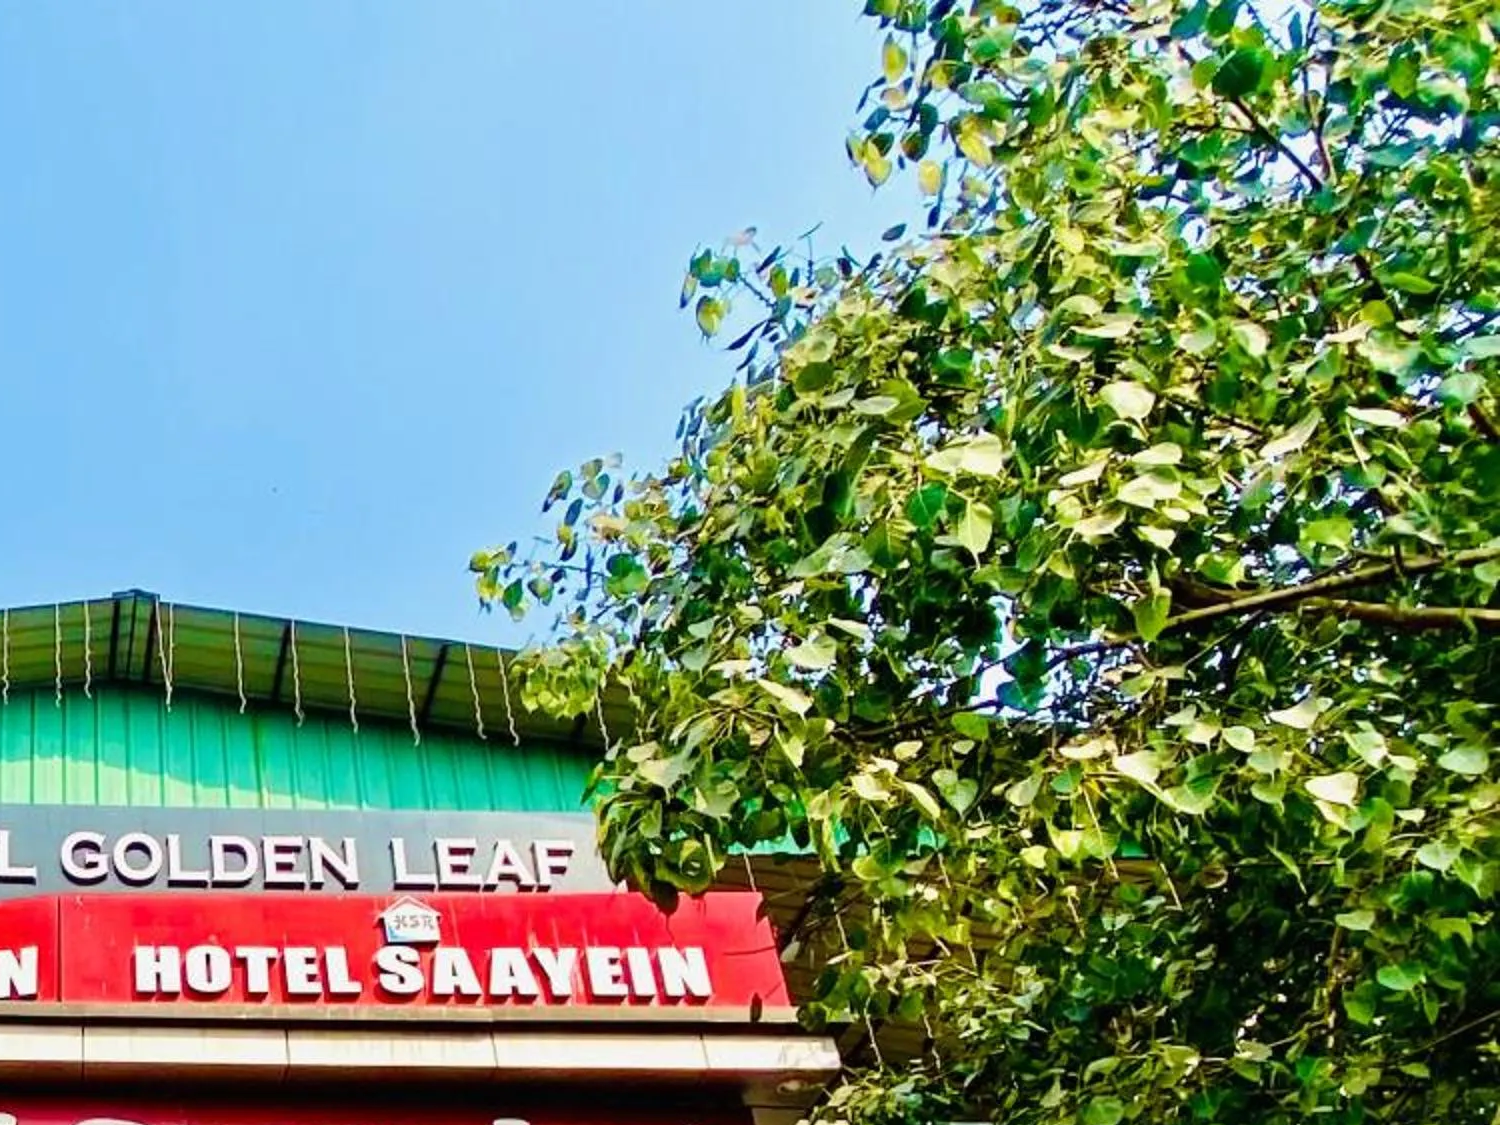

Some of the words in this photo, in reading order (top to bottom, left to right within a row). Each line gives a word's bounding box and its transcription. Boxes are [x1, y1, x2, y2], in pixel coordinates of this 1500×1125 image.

[60, 831, 358, 889] GOLDEN
[392, 838, 575, 891] LEAF
[135, 945, 361, 1000] HOTEL
[378, 945, 711, 1003] SAAYEIN
